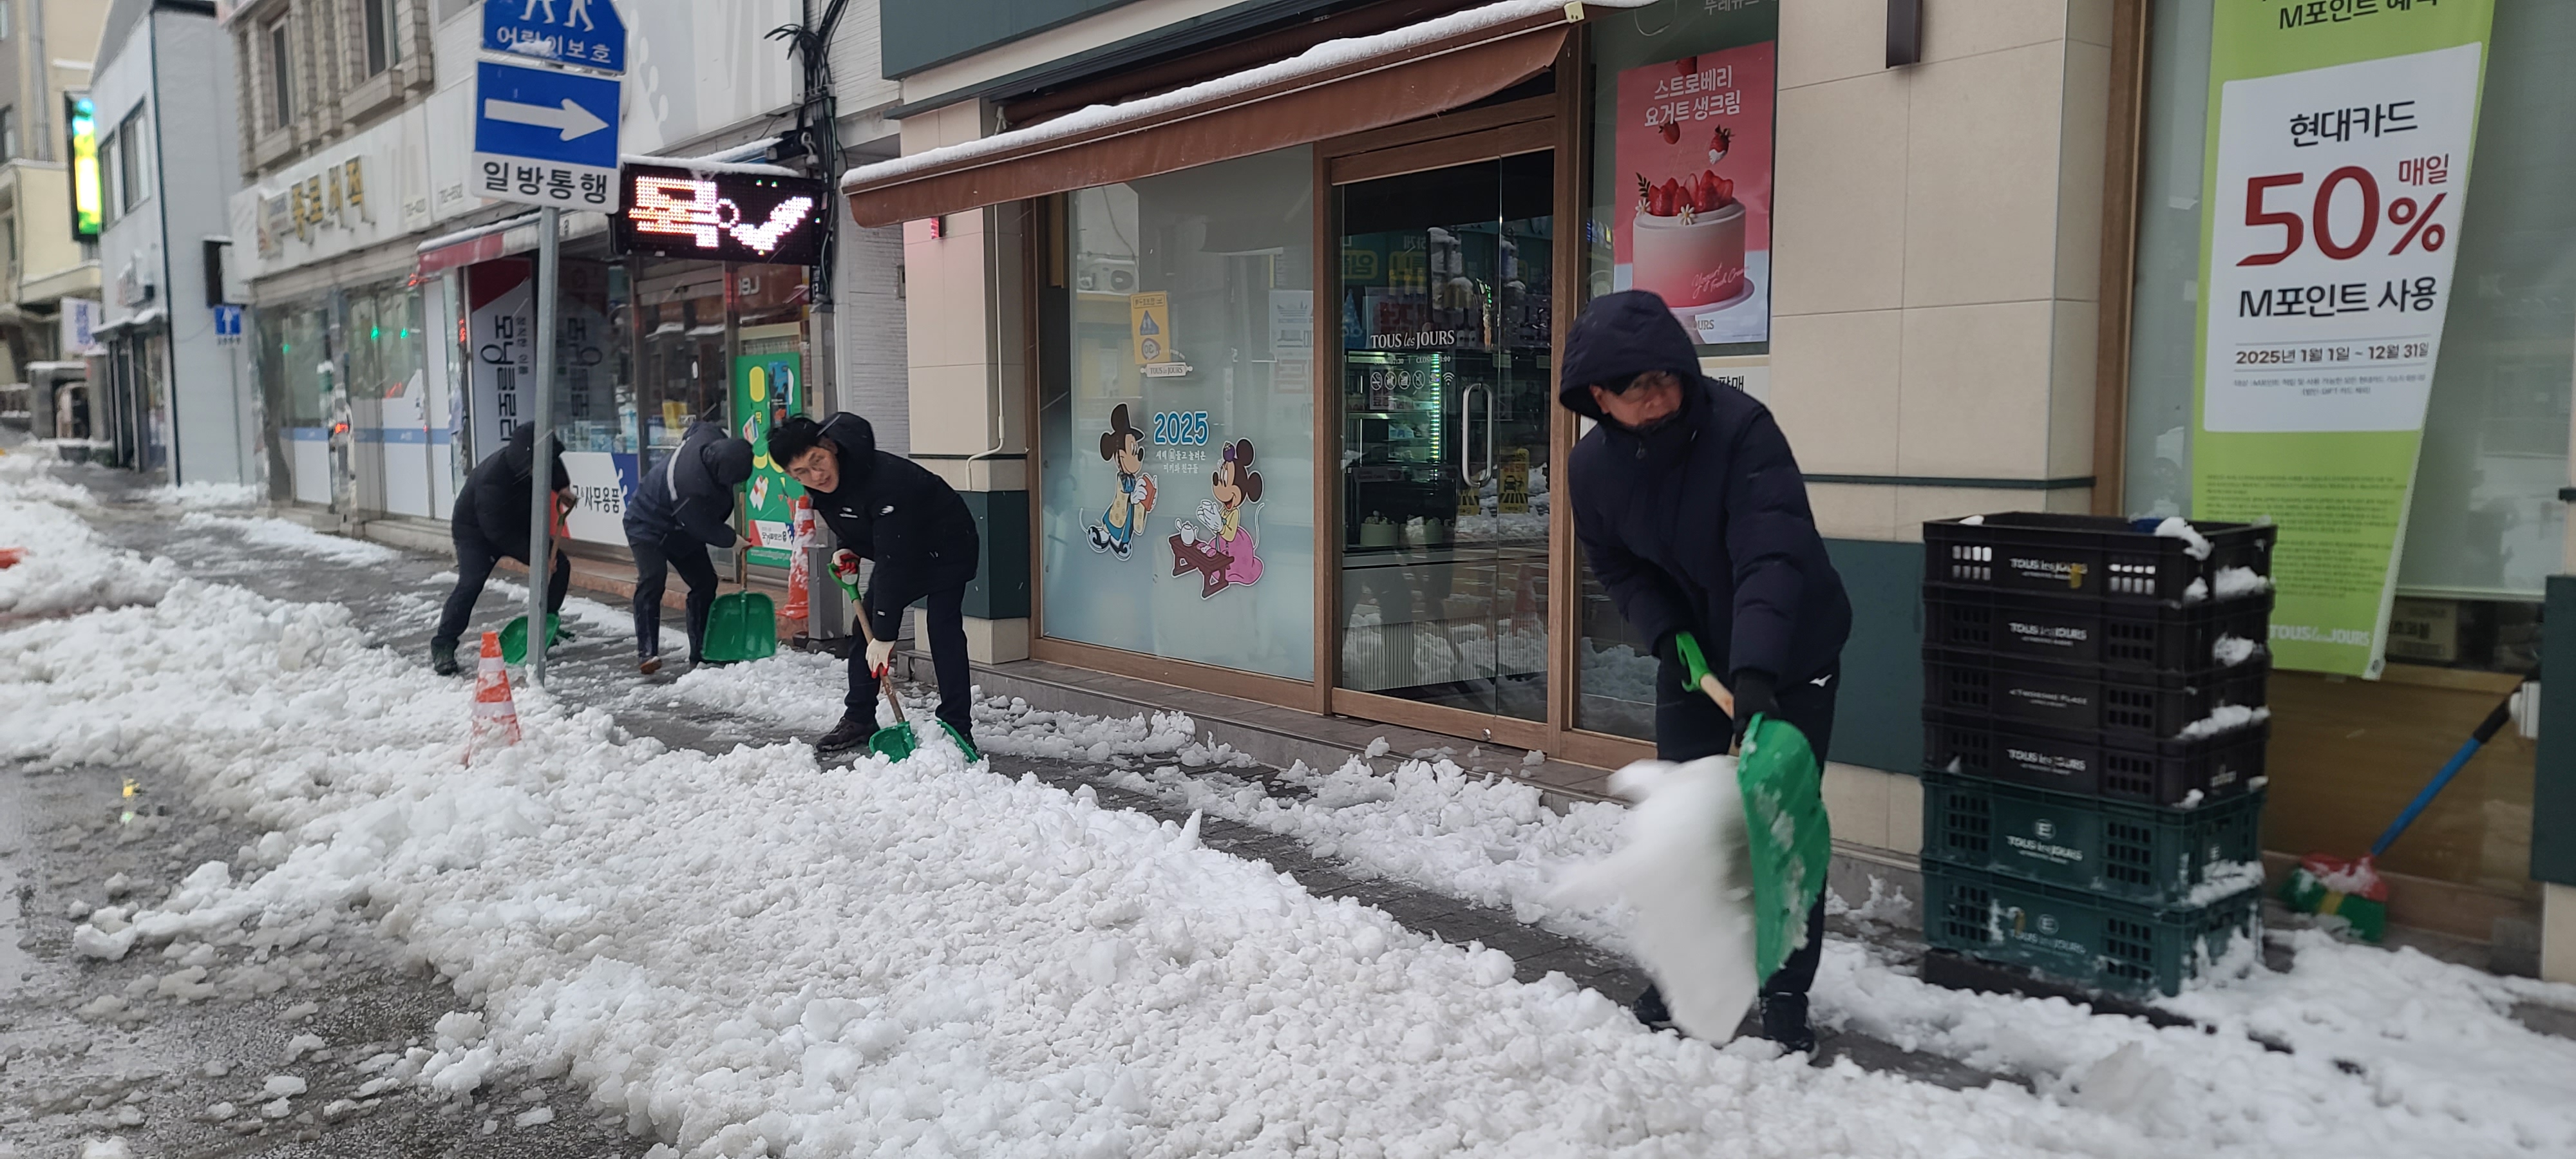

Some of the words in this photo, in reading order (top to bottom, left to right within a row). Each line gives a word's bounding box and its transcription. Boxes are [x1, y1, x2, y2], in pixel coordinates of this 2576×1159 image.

[1704, 0, 1759, 16] 뚜레
[1654, 65, 1732, 100] 스트로베리
[1644, 101, 1690, 127] 요거트
[1692, 90, 1741, 121] 생크림
[2290, 100, 2418, 147] 현대카드
[484, 162, 607, 204] 일방통행
[2398, 153, 2449, 185] 매일
[2235, 165, 2448, 267] 50%
[2239, 283, 2370, 317] M포인트
[2377, 276, 2438, 312] 사용
[1370, 333, 1402, 348] TOUS
[1404, 332, 1416, 347] les
[1416, 330, 1455, 350] JOURS
[2235, 349, 2295, 364] 2025년
[2301, 348, 2322, 362] 1월
[2328, 346, 2350, 361] 1일
[2368, 344, 2400, 359] 12월
[2403, 342, 2429, 359] 31일
[1168, 366, 1183, 375] JOURS
[1153, 411, 1209, 446] 2025
[2269, 625, 2310, 641] TOUS
